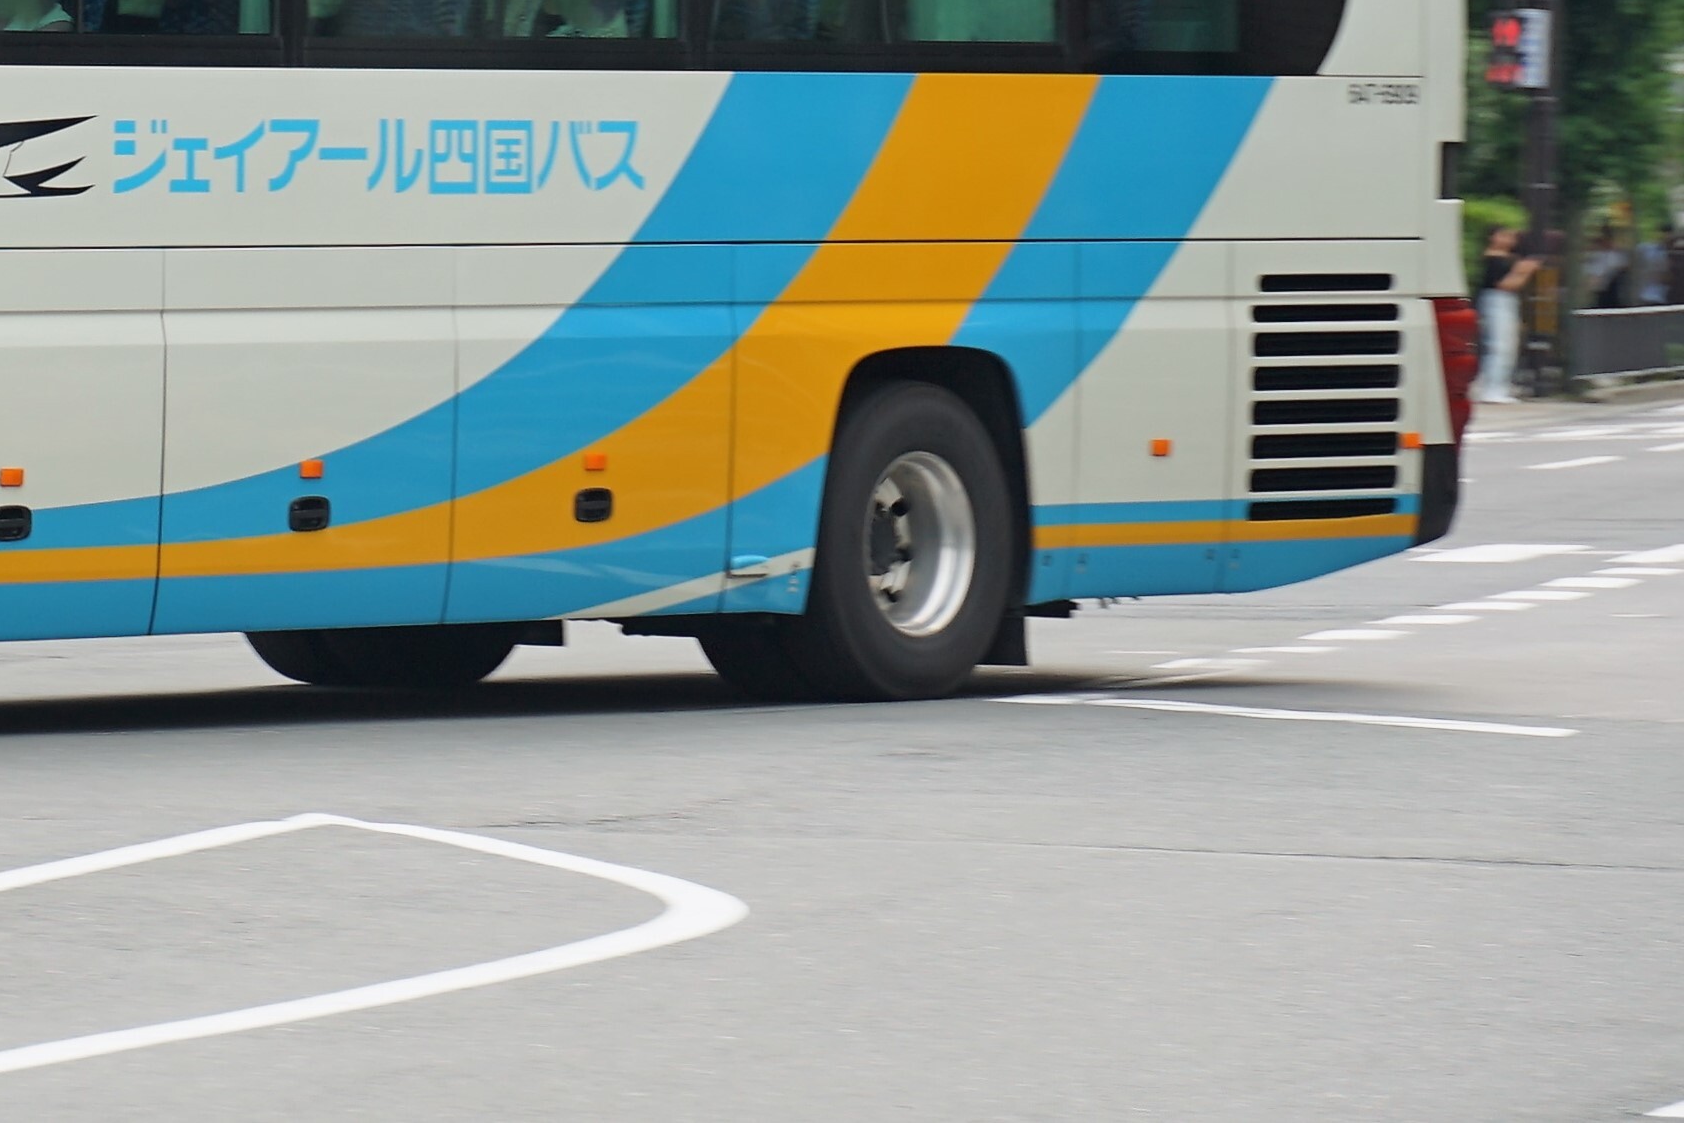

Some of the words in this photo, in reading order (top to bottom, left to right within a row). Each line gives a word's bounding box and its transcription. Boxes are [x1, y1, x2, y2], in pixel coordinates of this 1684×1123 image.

[112, 118, 646, 194] ジェイアール四国バス
